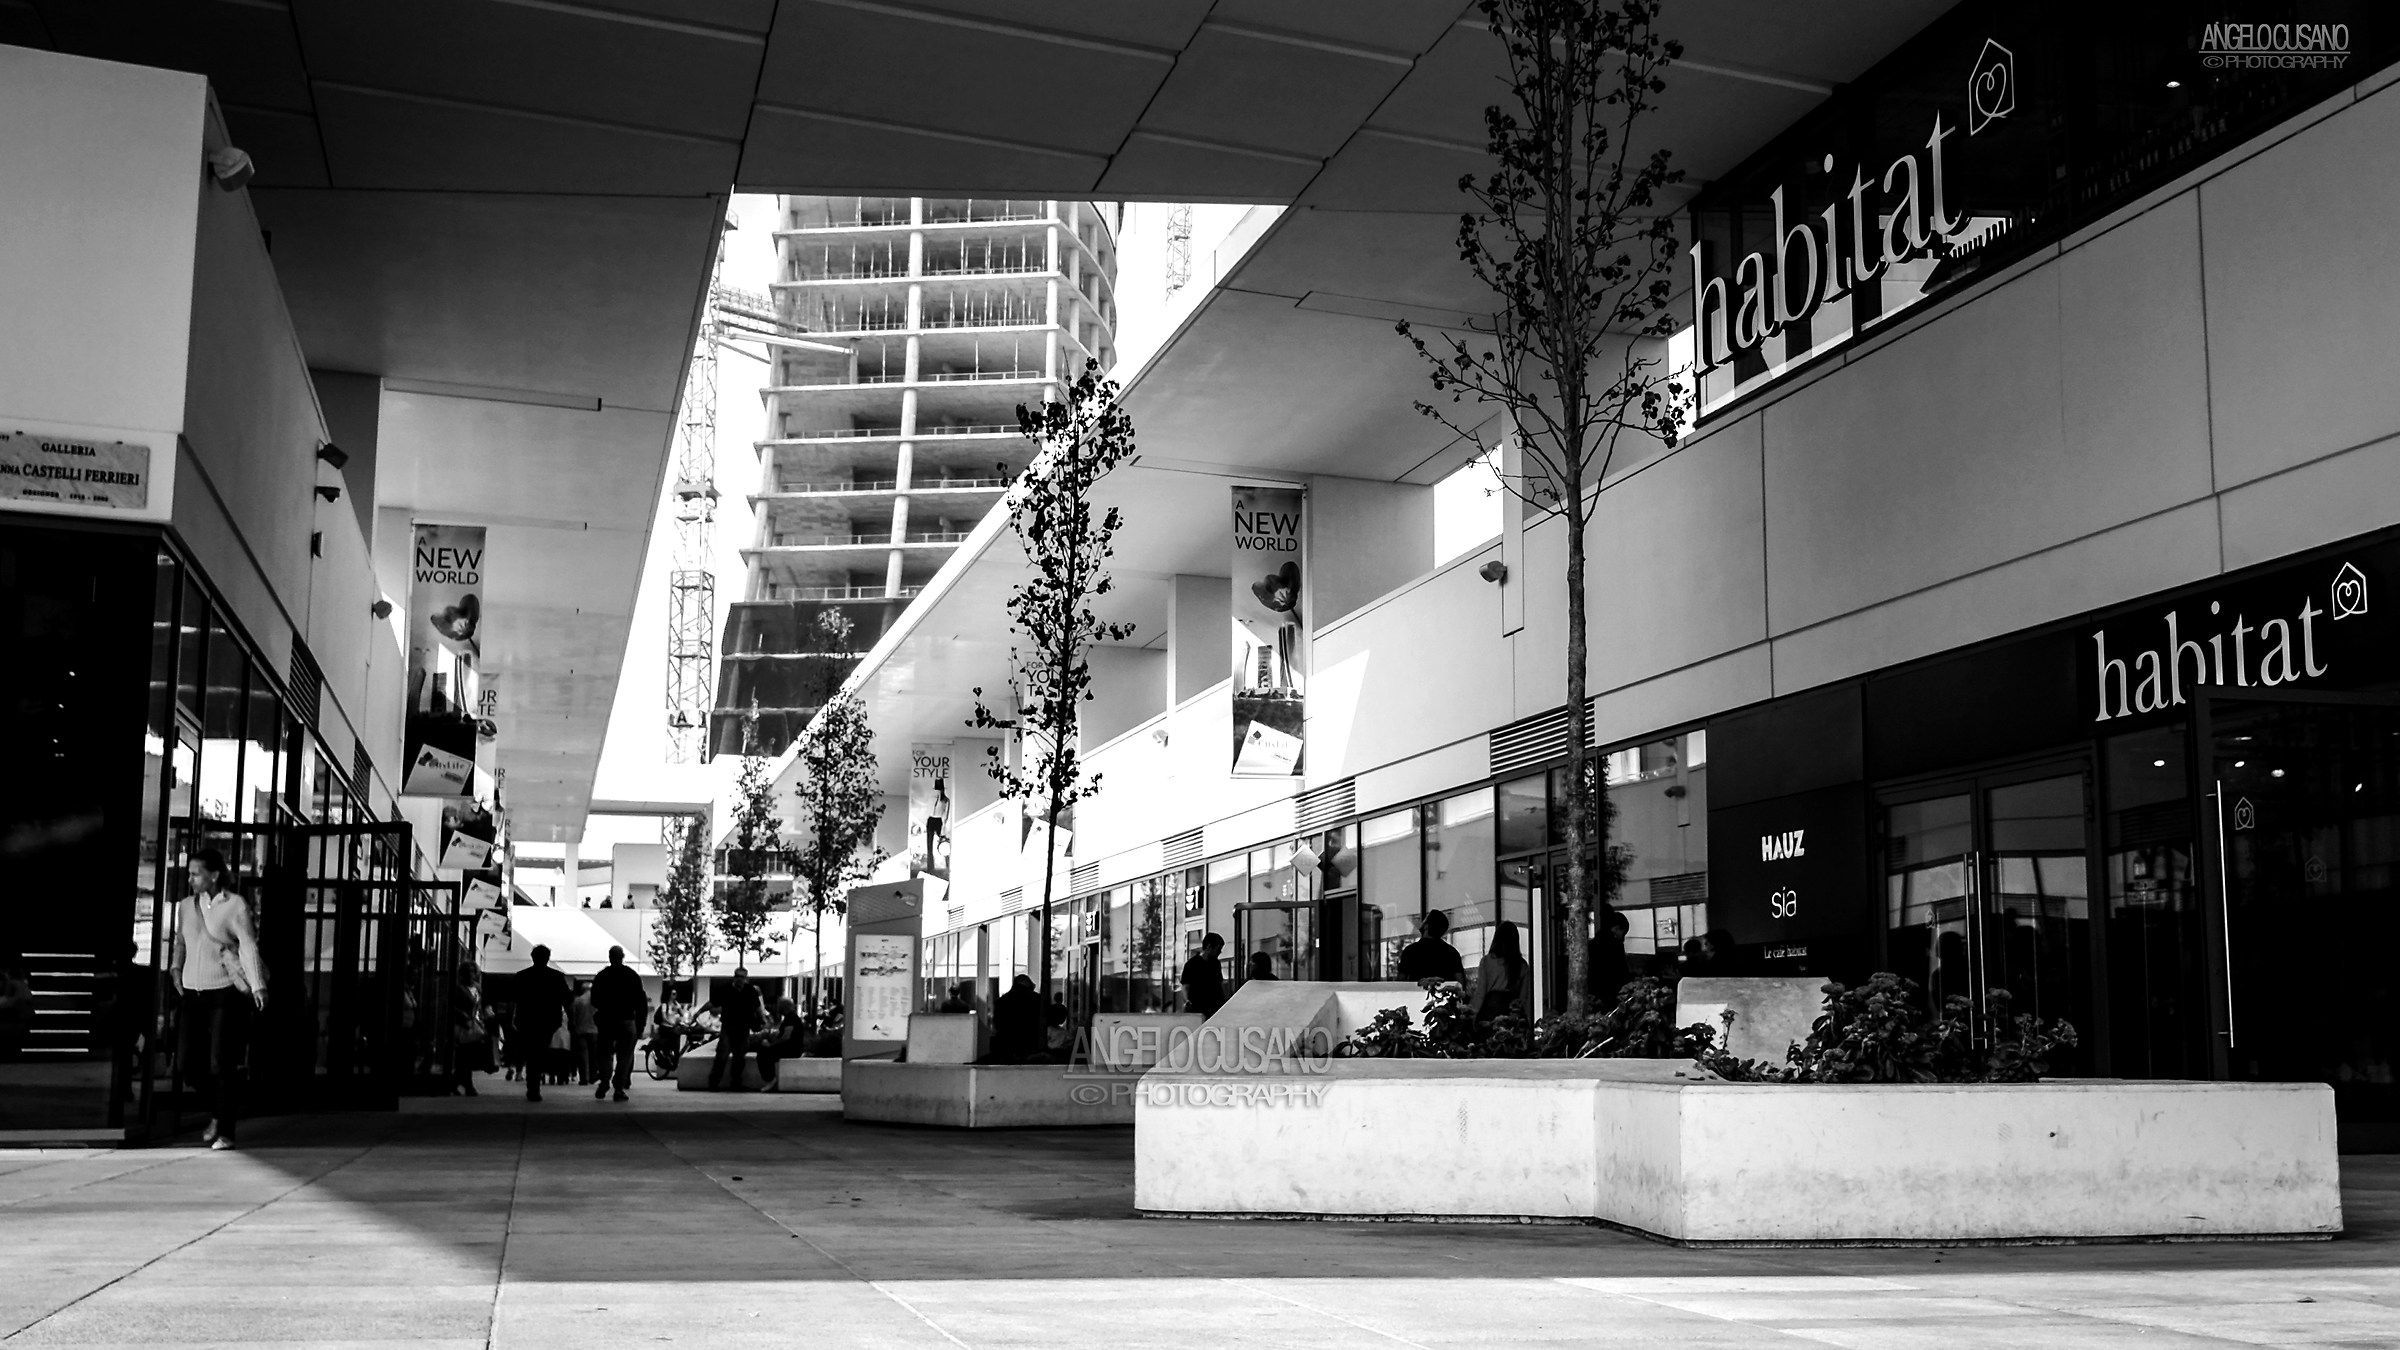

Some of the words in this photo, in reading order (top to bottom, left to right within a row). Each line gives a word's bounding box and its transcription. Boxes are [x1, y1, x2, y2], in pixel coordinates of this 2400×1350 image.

[1690, 109, 1964, 374] habitat
[41, 442, 96, 457] GALLERIA
[0, 464, 20, 476] NNA
[22, 463, 82, 481] CASTELLI
[84, 468, 140, 486] FERRIERI
[1235, 499, 1245, 510] A
[1234, 511, 1300, 536] NEW
[418, 536, 427, 547] A
[1234, 535, 1299, 552] WORLD
[415, 547, 482, 570] NEW
[415, 569, 479, 586] WORLD
[1026, 661, 1043, 669] FOR
[2092, 595, 2328, 722] habitat
[913, 756, 950, 768] YOUR
[913, 767, 949, 779] STYLE
[1761, 829, 1805, 862] HAUZ
